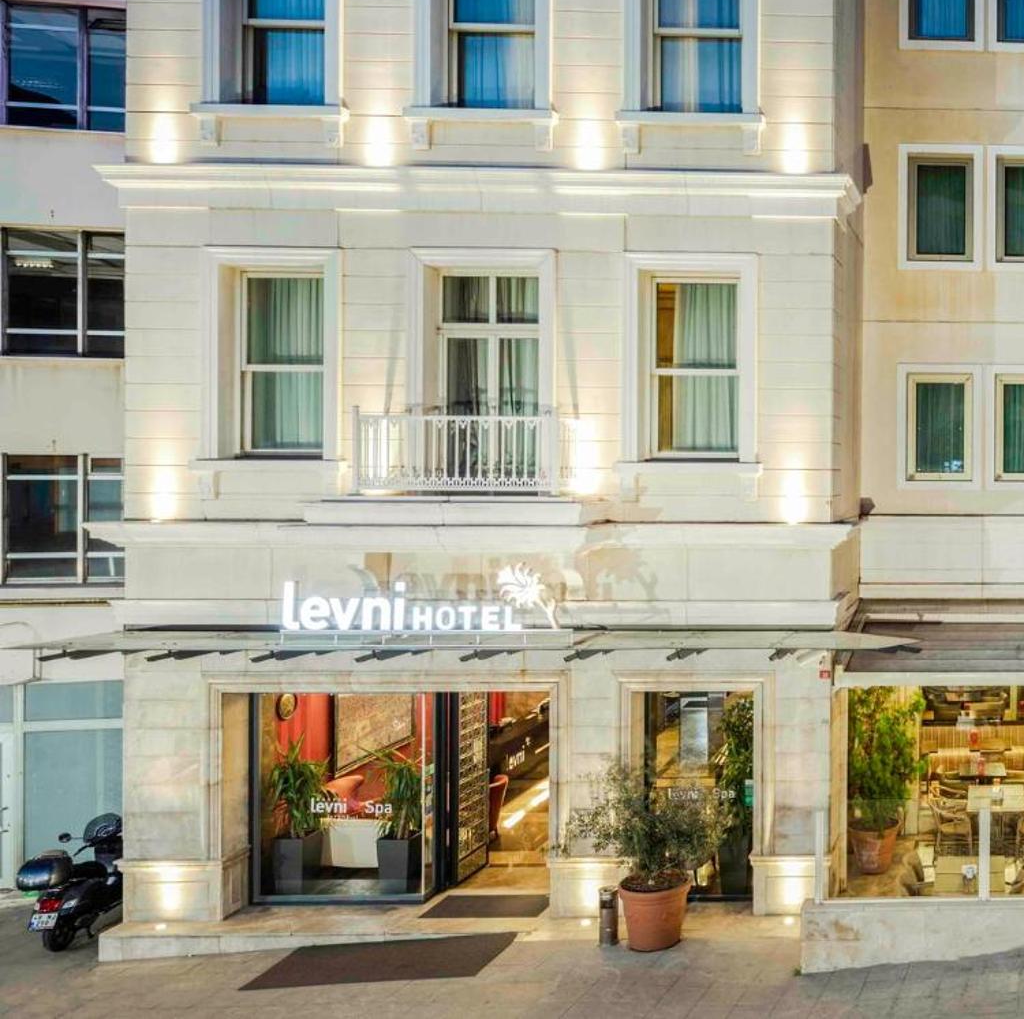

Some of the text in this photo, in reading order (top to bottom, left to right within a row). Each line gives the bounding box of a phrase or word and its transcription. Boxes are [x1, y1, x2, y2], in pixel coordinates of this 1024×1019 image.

[282, 581, 522, 631] levni HOTEL
[365, 800, 393, 817] Spa
